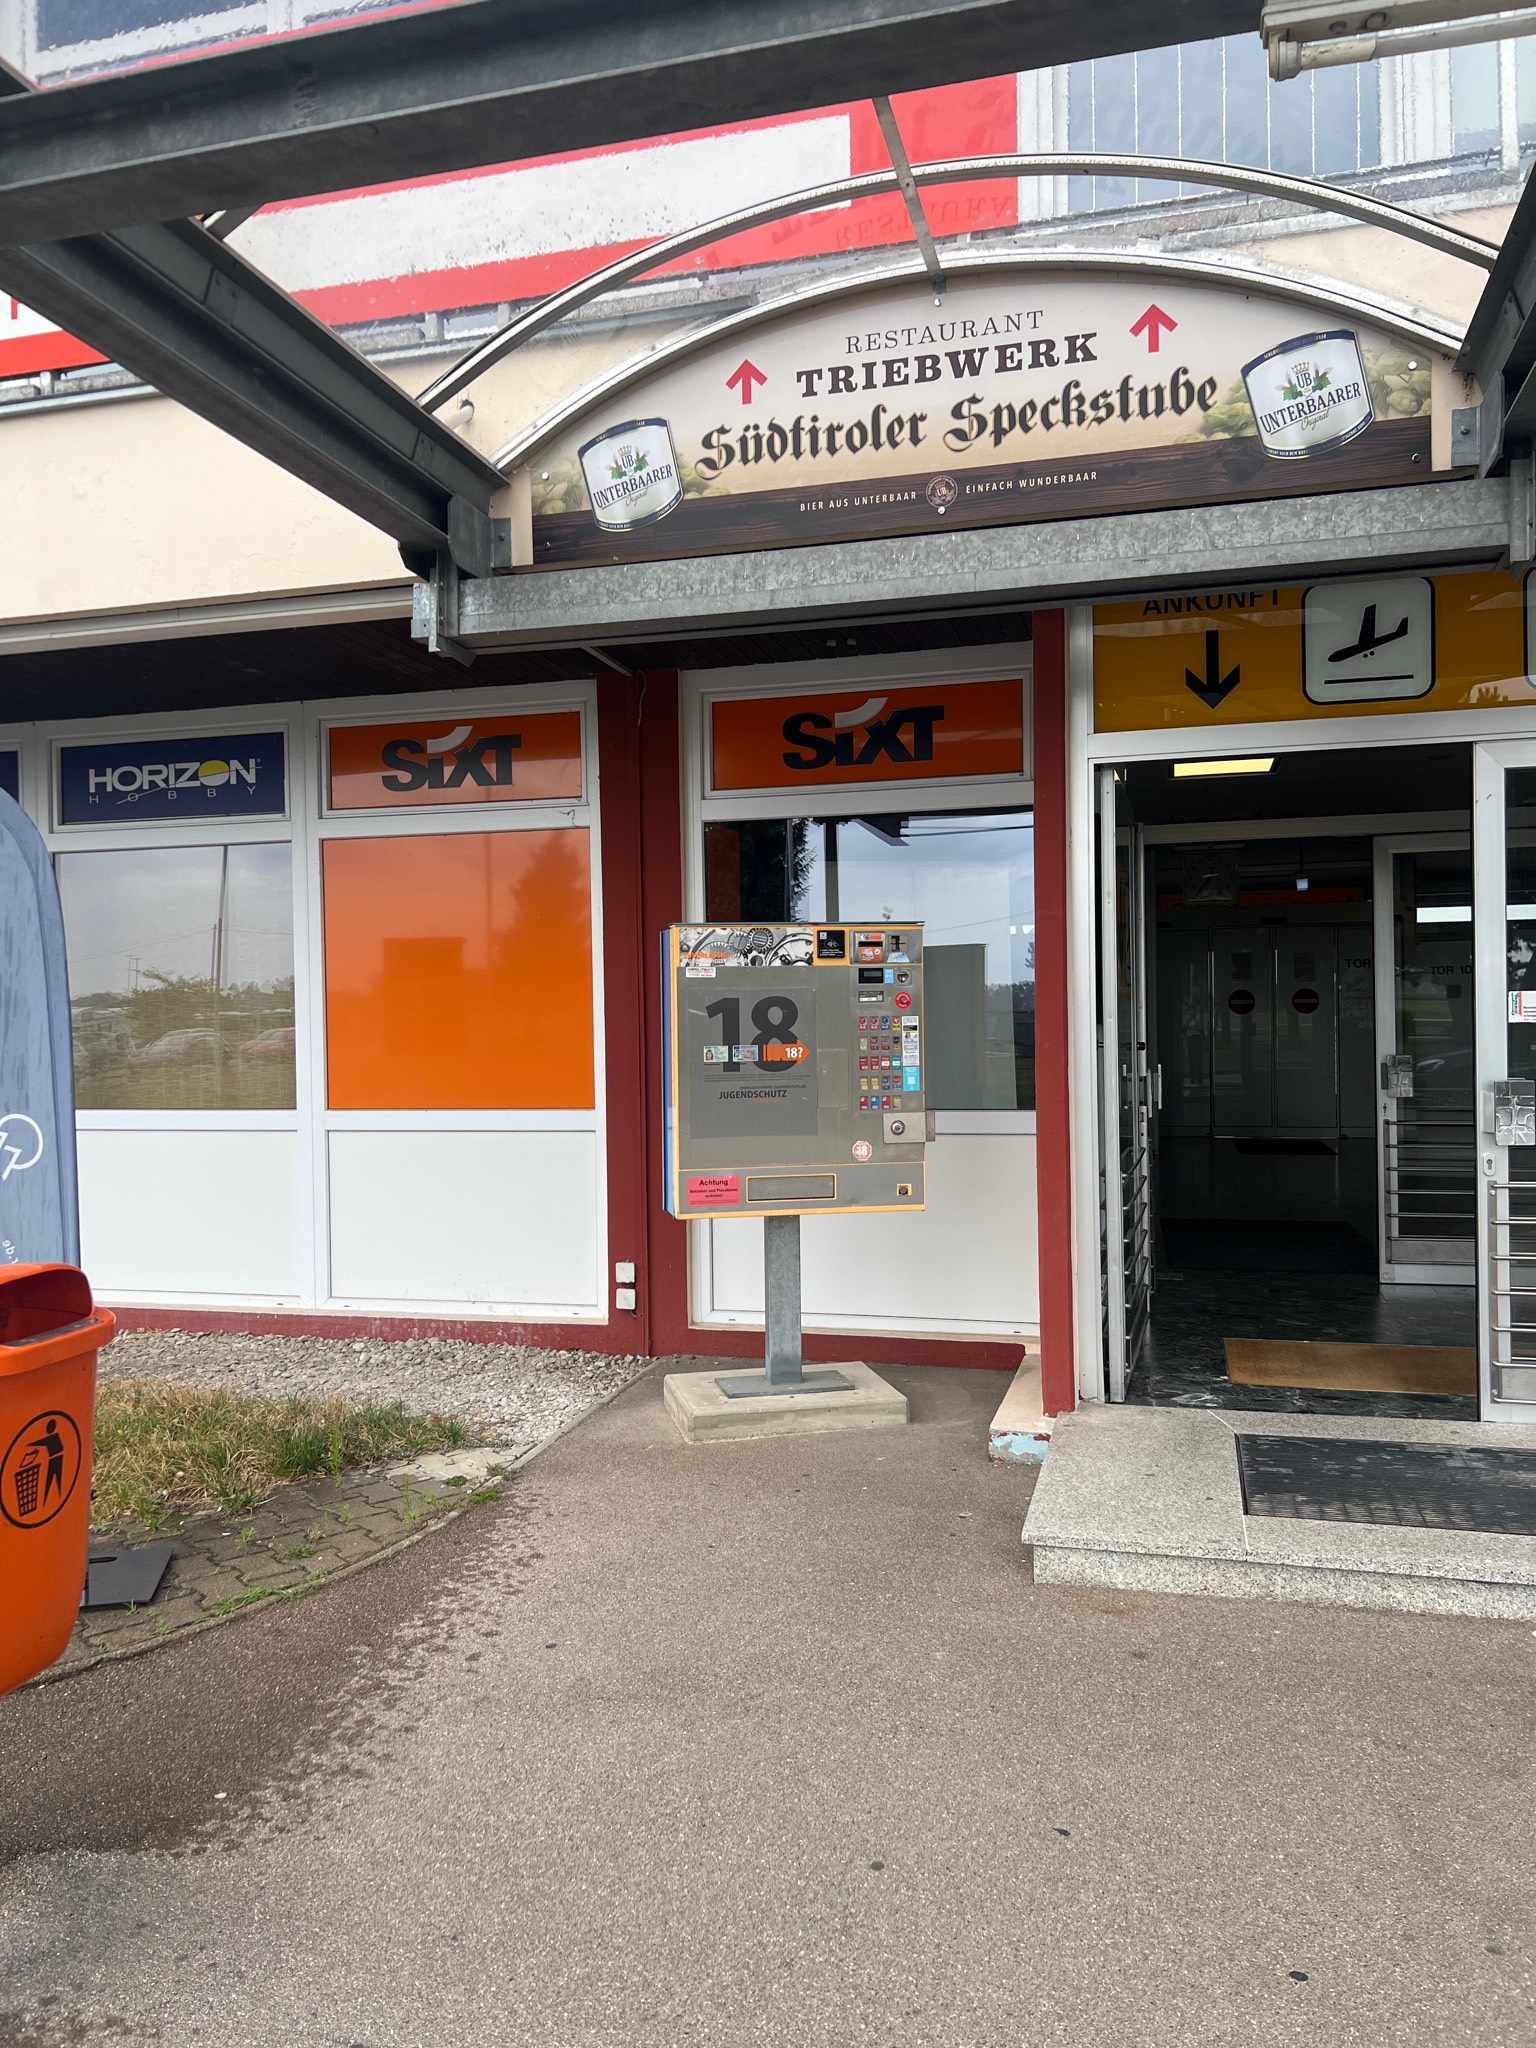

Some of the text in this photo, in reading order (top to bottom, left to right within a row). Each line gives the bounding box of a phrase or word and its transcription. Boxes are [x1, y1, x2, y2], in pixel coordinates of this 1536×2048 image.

[844, 309, 1044, 355] RESTAURANT
[795, 331, 1099, 398] TRIEBWERK
[1296, 371, 1313, 389] UB
[1259, 381, 1362, 434] UNTERBAARER
[694, 366, 1218, 481] Südtiroler Speckstube
[621, 454, 635, 469] UB
[592, 464, 673, 509] UNTERBAARER
[966, 480, 1013, 494] EINFACH
[1019, 471, 1097, 488] WUNDERBAAR
[800, 491, 917, 512] BIER AUS UNTERBAAR
[89, 758, 256, 793] HORIZON
[1430, 965, 1455, 976] TOR
[705, 995, 799, 1073] 18
[785, 1047, 804, 1059] 18?
[718, 1089, 788, 1100] JUGENDSCHUTZ
[699, 1179, 729, 1187] Achtung
